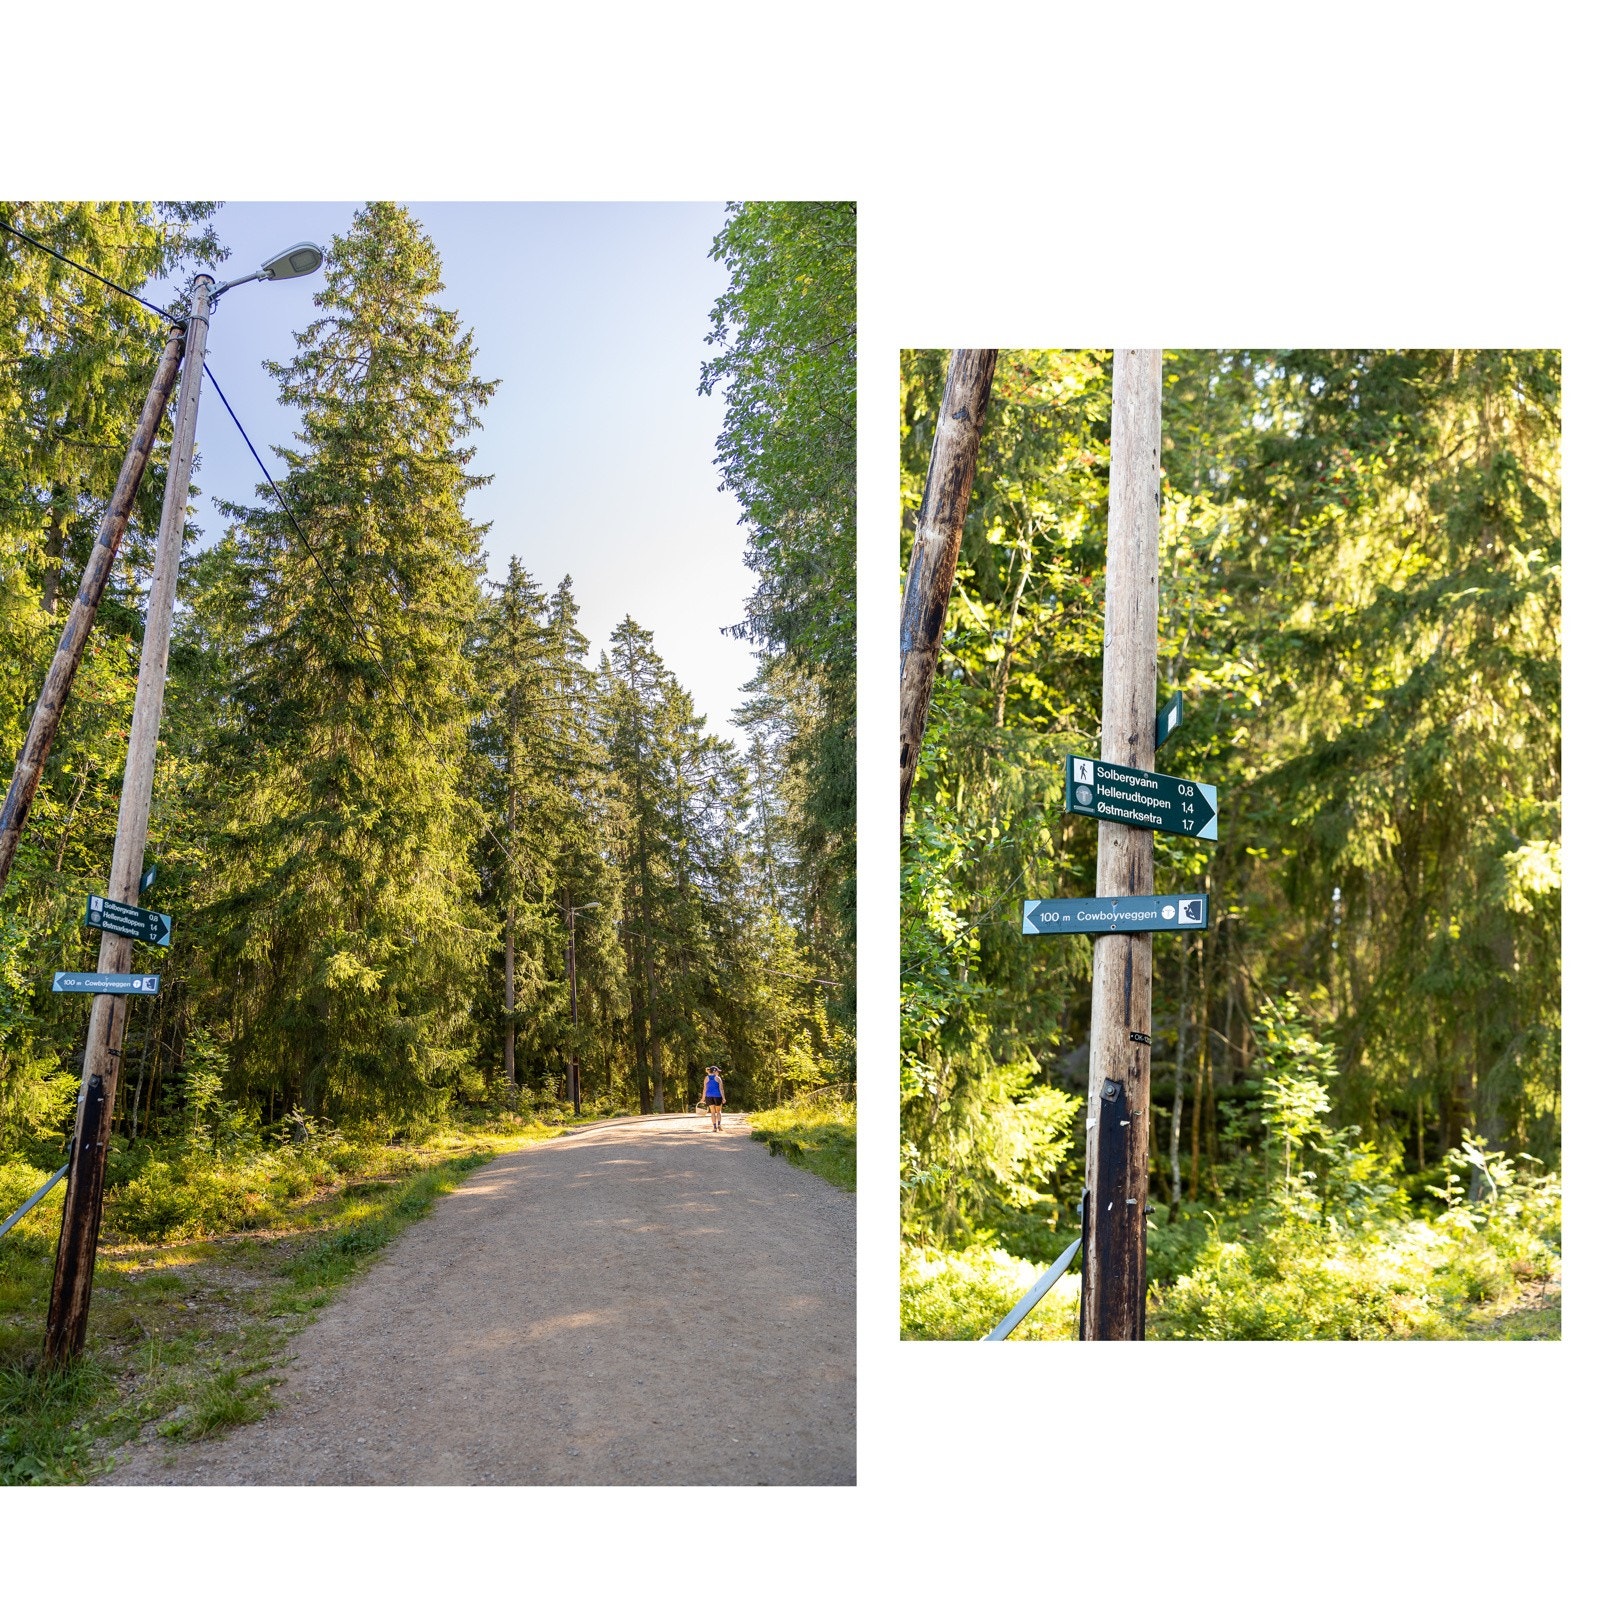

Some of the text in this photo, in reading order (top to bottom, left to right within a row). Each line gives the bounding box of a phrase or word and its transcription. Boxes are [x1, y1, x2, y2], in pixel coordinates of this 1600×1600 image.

[1097, 767, 1194, 797] Solbergvann 0,8
[1096, 784, 1194, 814] Hellerudtoppen 1,4
[1097, 802, 1194, 831] Østmarksetra 1,7
[104, 902, 139, 917] Solbergvann
[1039, 912, 1060, 922] 100
[1077, 910, 1157, 922] Cowboyveggen
[103, 911, 145, 928] Hellerudtoppen
[84, 979, 131, 988] Cowboyveggen
